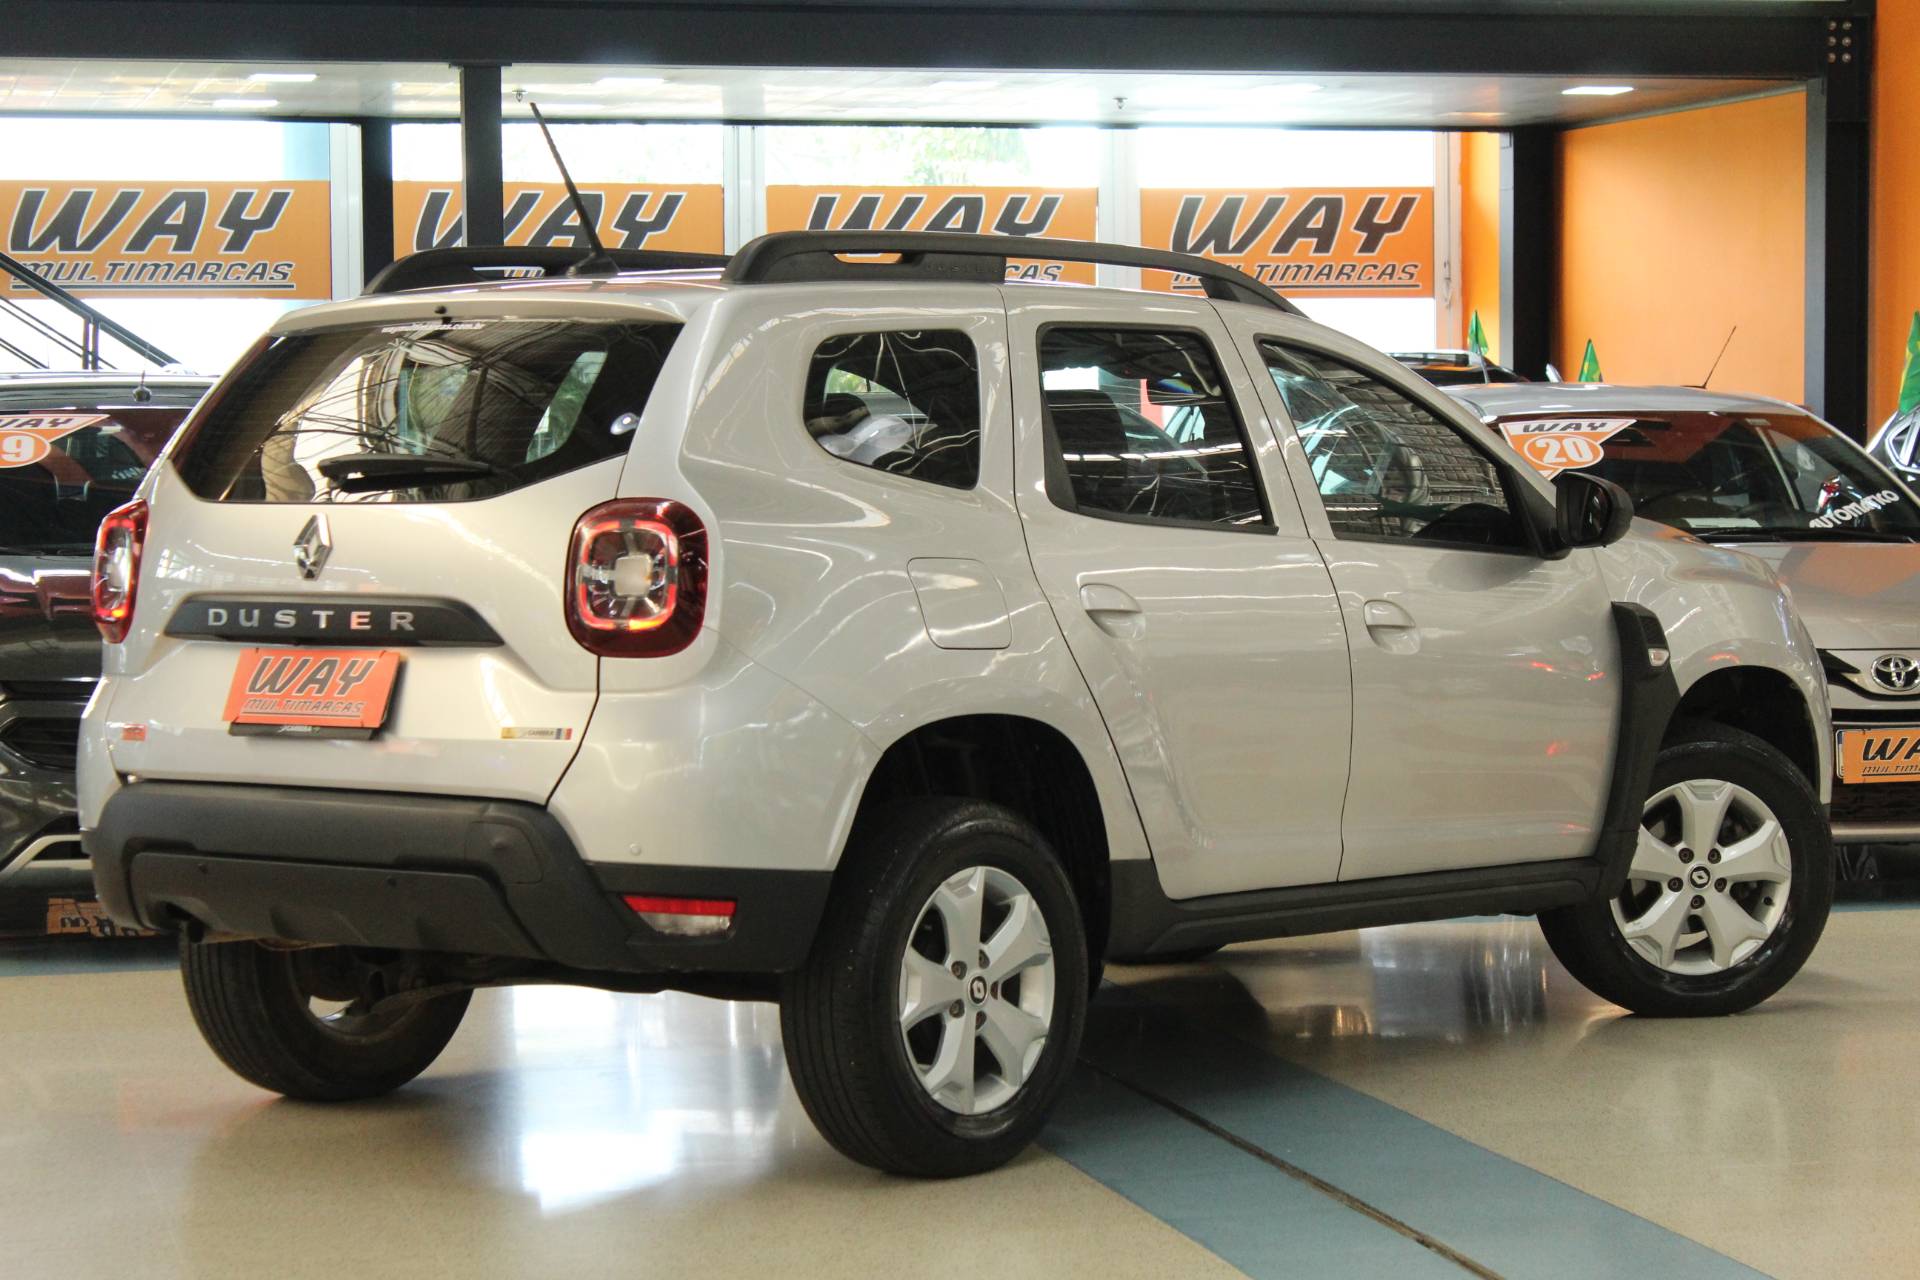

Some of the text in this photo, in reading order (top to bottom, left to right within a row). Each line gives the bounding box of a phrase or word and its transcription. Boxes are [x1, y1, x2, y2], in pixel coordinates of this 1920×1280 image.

[9, 188, 294, 254] WAY
[413, 189, 687, 250] WAY
[805, 193, 1064, 236] WAY
[1169, 194, 1421, 256] WAY
[1172, 263, 1421, 282] TIMARCAS
[1523, 422, 1608, 433] WAY
[1535, 437, 1594, 463] 20
[207, 607, 416, 632] DUSTER
[246, 656, 379, 696] WAY
[242, 698, 366, 714] MULTIMARCAS
[1862, 736, 1920, 761] WA
